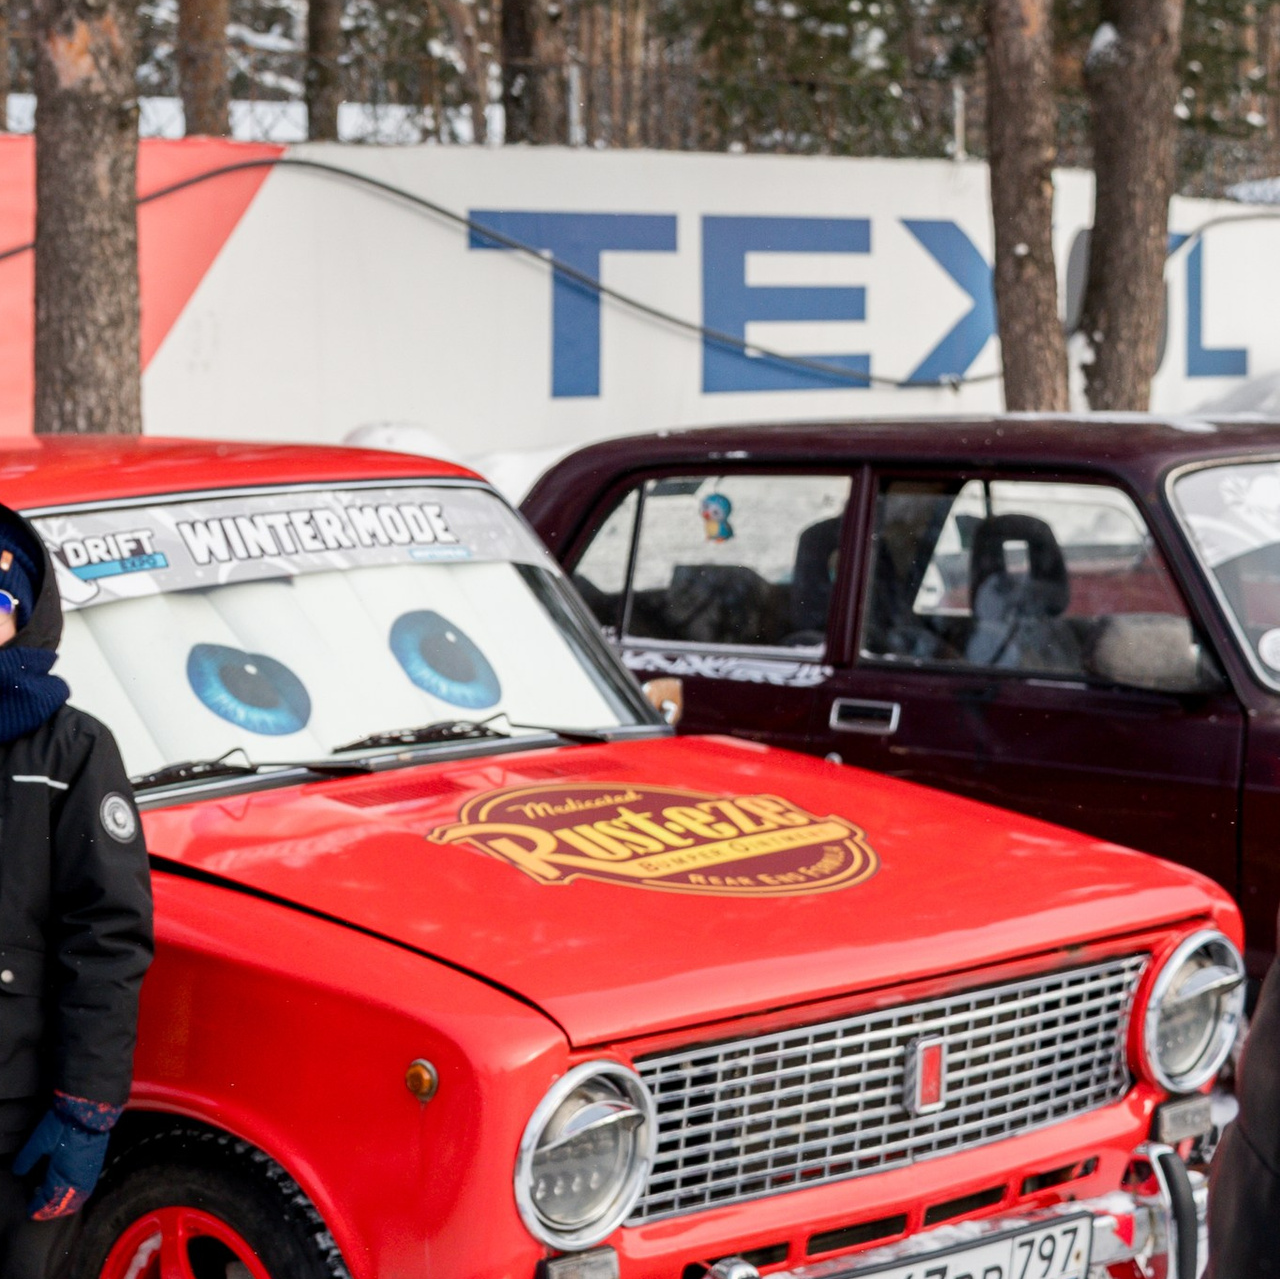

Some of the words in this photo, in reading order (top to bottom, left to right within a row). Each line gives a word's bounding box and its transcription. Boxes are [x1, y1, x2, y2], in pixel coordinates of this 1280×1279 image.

[63, 530, 157, 568] DRIFT
[176, 508, 349, 566] WINTER
[346, 502, 460, 549] MODE
[119, 555, 158, 573] EXPO
[506, 789, 644, 820] Medicated
